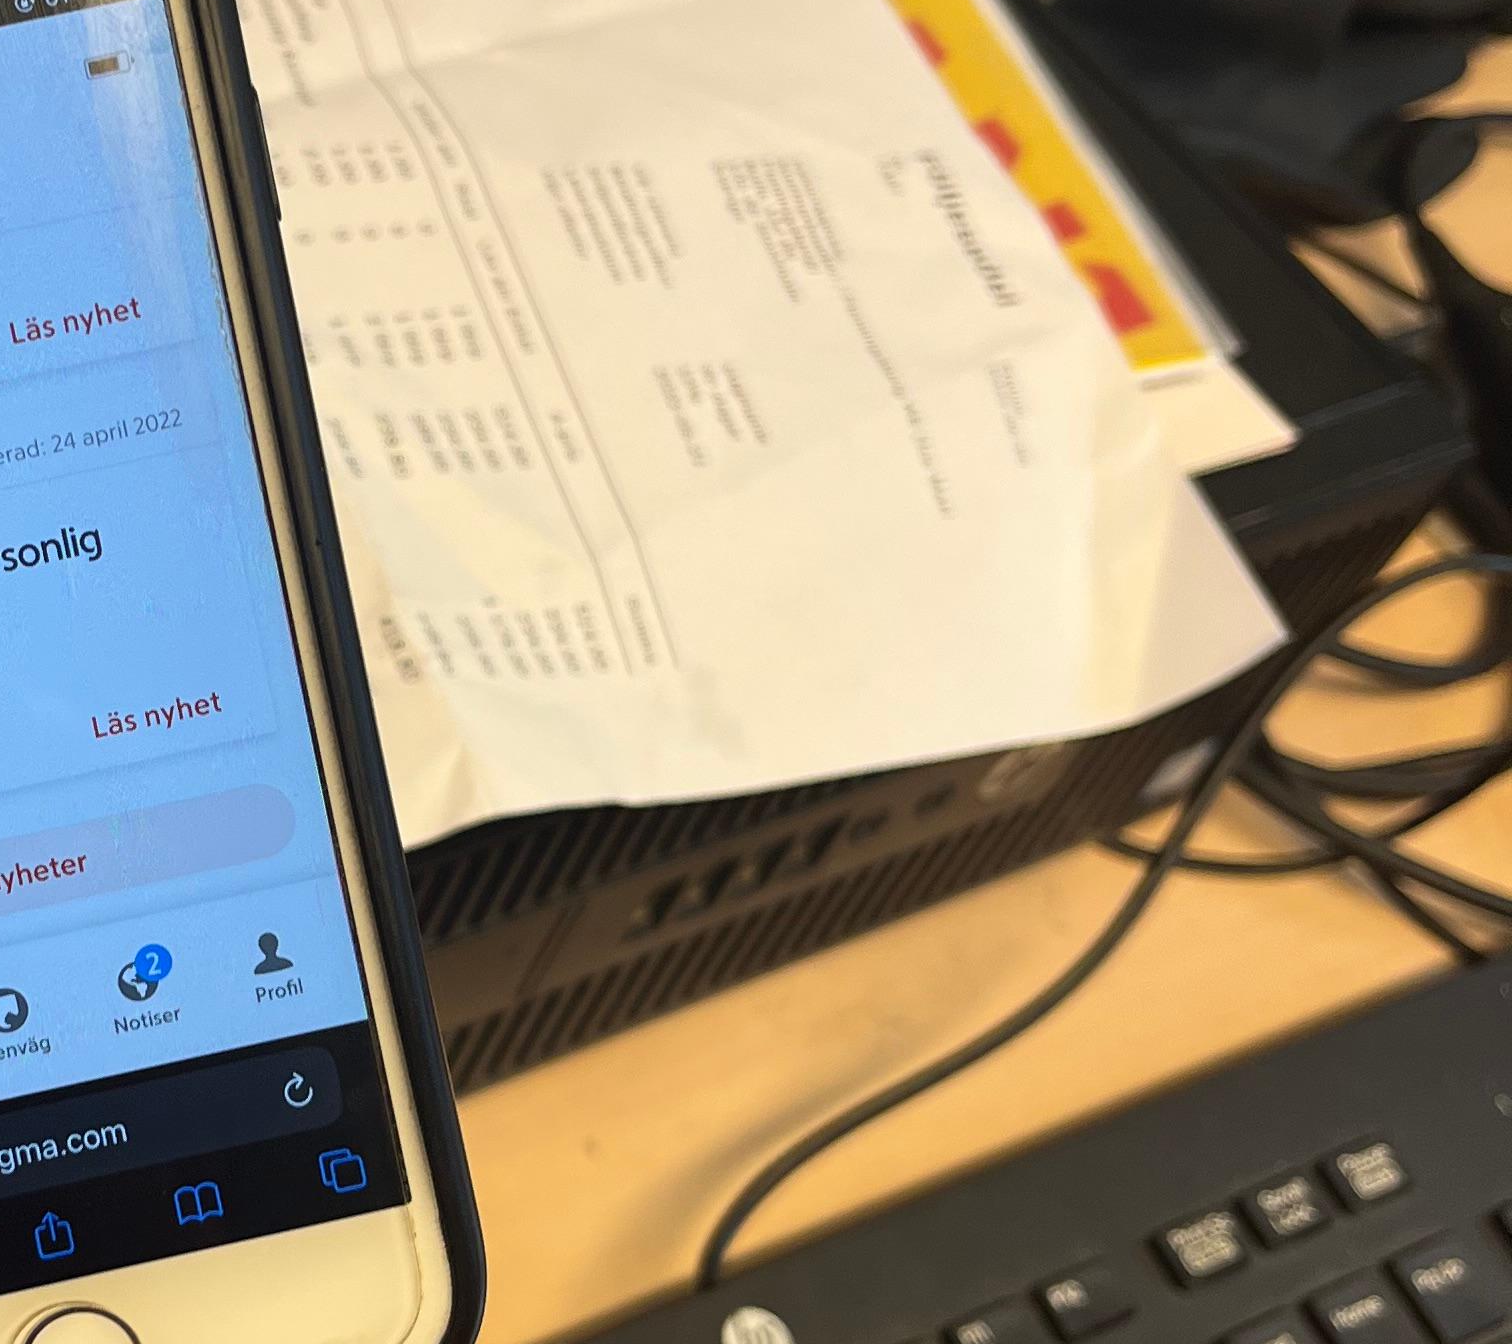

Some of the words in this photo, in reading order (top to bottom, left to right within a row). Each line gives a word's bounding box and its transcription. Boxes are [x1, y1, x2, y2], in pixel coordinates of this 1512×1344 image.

[8, 315, 56, 345] Läs
[62, 297, 143, 335] nyhet
[51, 430, 77, 454] 24
[82, 418, 129, 448] april
[133, 407, 183, 436] 2022
[91, 710, 138, 740] Läs
[144, 690, 223, 729] nyhet
[145, 951, 163, 977] 2
[254, 976, 306, 1004] Profil
[112, 1004, 183, 1035] Notiser
